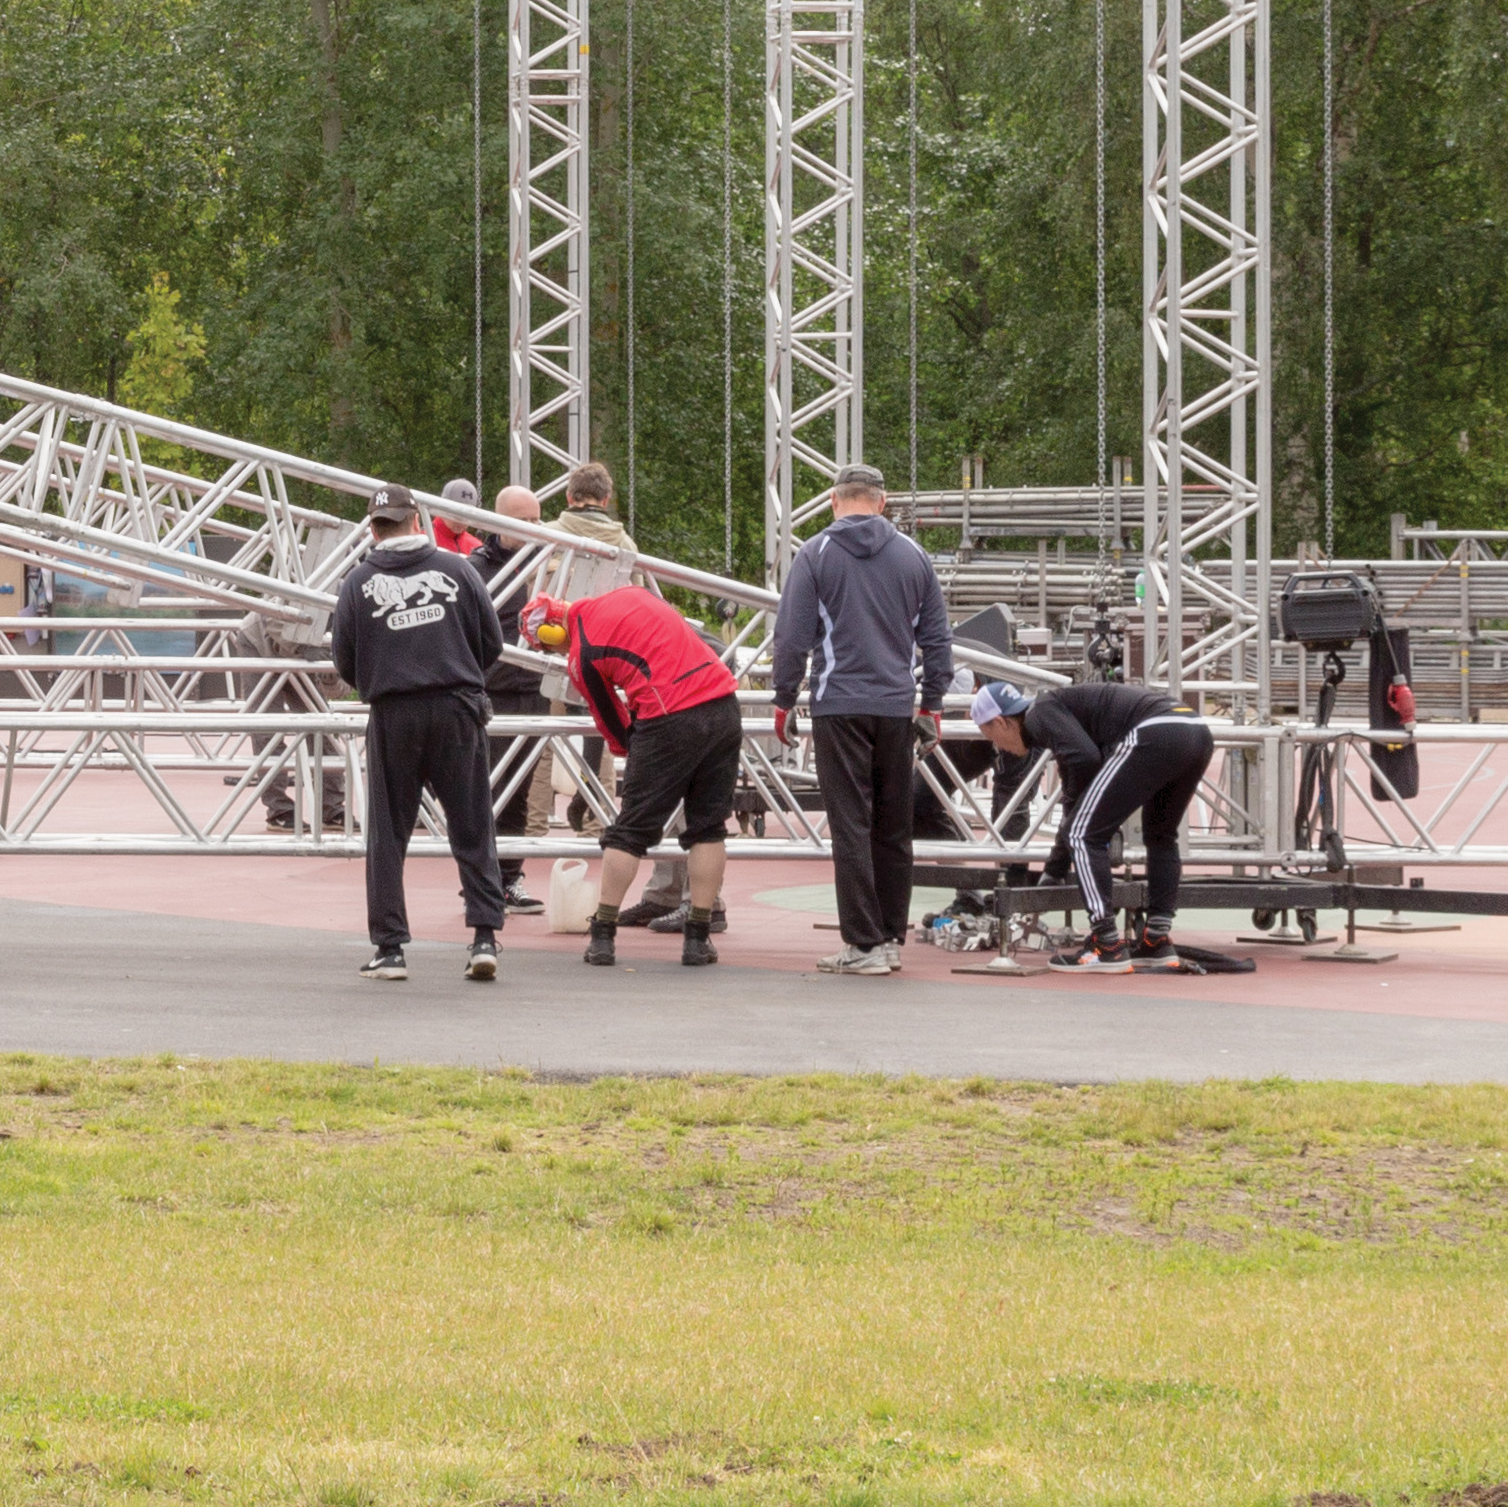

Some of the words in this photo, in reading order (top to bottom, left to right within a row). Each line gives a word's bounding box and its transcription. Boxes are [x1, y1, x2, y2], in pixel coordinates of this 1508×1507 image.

[375, 491, 389, 506] NY
[391, 613, 411, 627] EST
[415, 607, 441, 622] 1960
